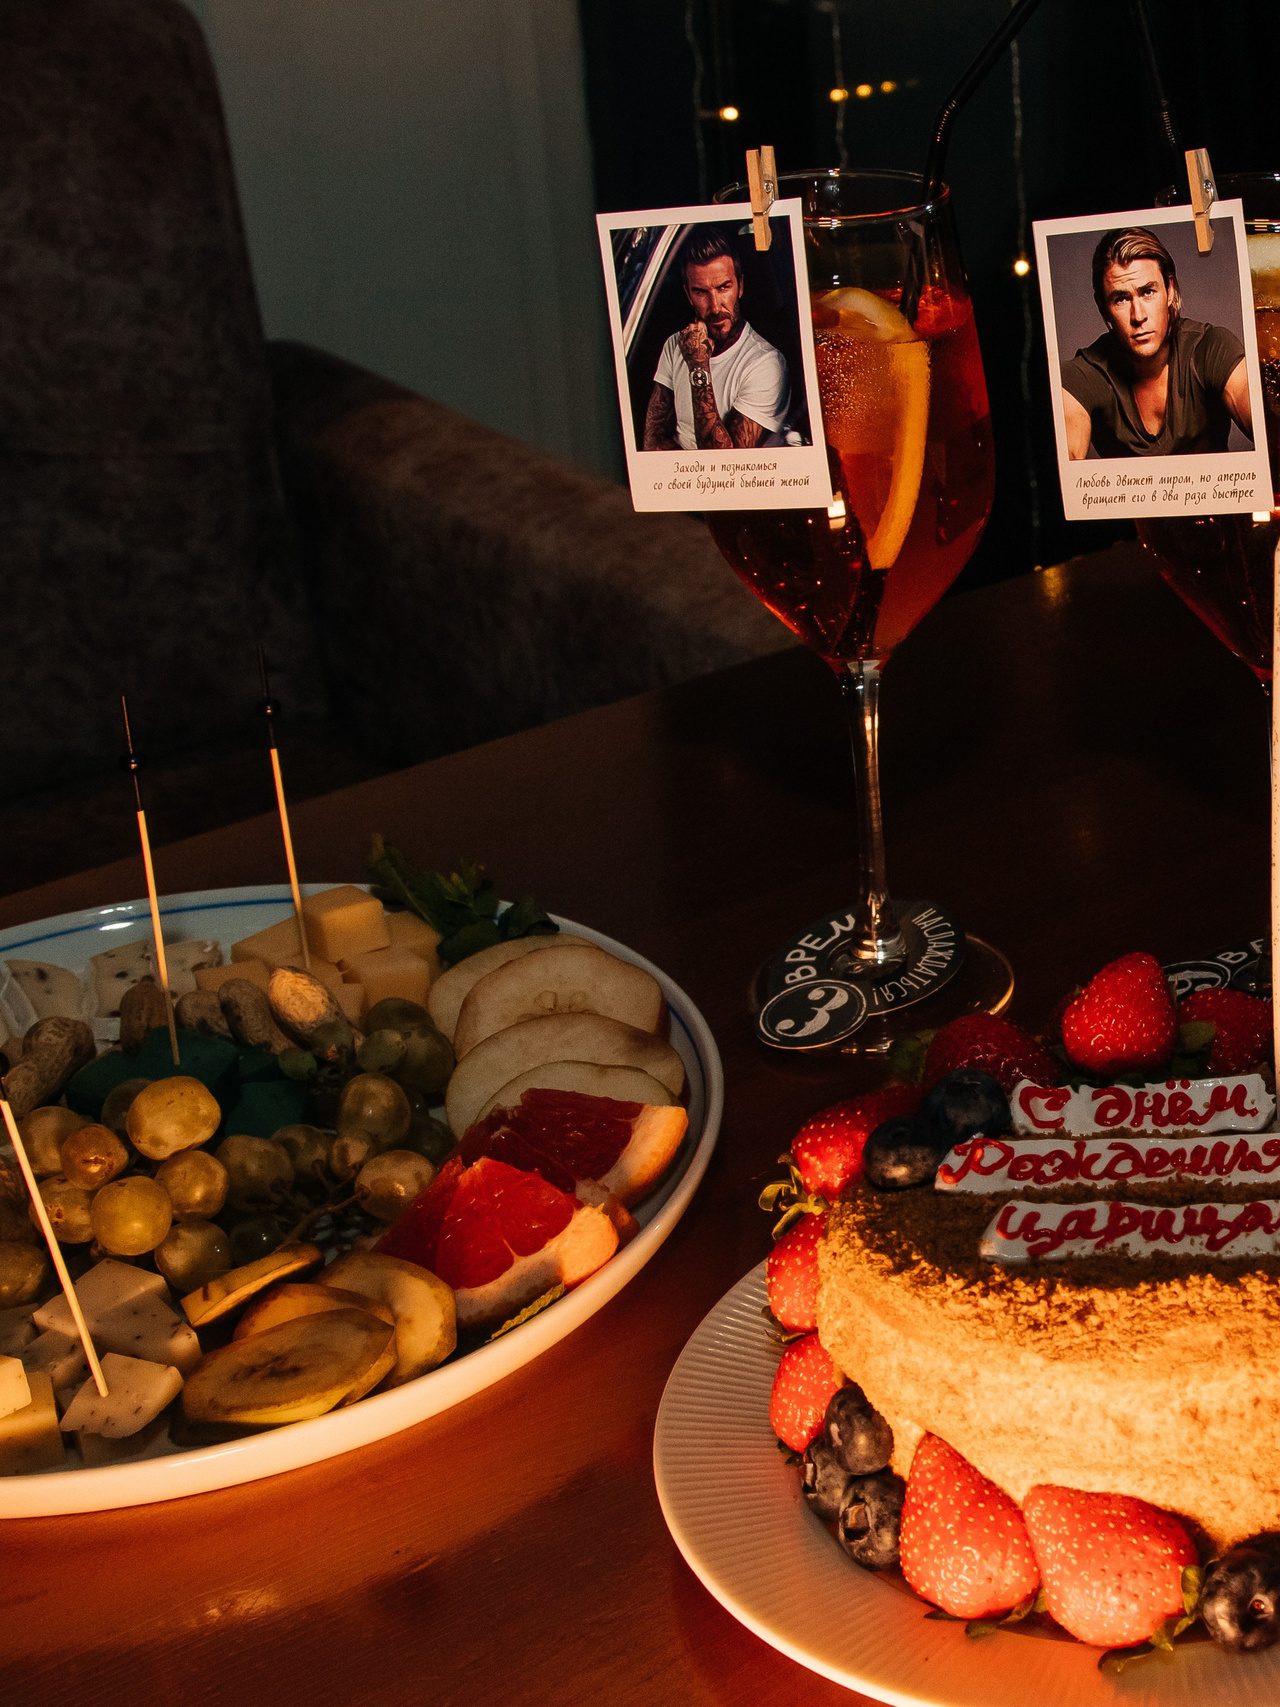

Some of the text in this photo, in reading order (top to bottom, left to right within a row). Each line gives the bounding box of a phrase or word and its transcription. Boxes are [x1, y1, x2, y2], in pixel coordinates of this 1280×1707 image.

[674, 461, 705, 474] Заходи
[721, 463, 777, 476] познакомься
[1076, 472, 1257, 489] Любовь движет миром, но апероль
[654, 474, 810, 494] со своей будущей бывшей женой
[1082, 485, 1255, 509] вращает его в два раза быстрее
[784, 914, 857, 985] ВРЕМ
[775, 985, 849, 1038] 3
[1019, 1086, 1071, 1129] С
